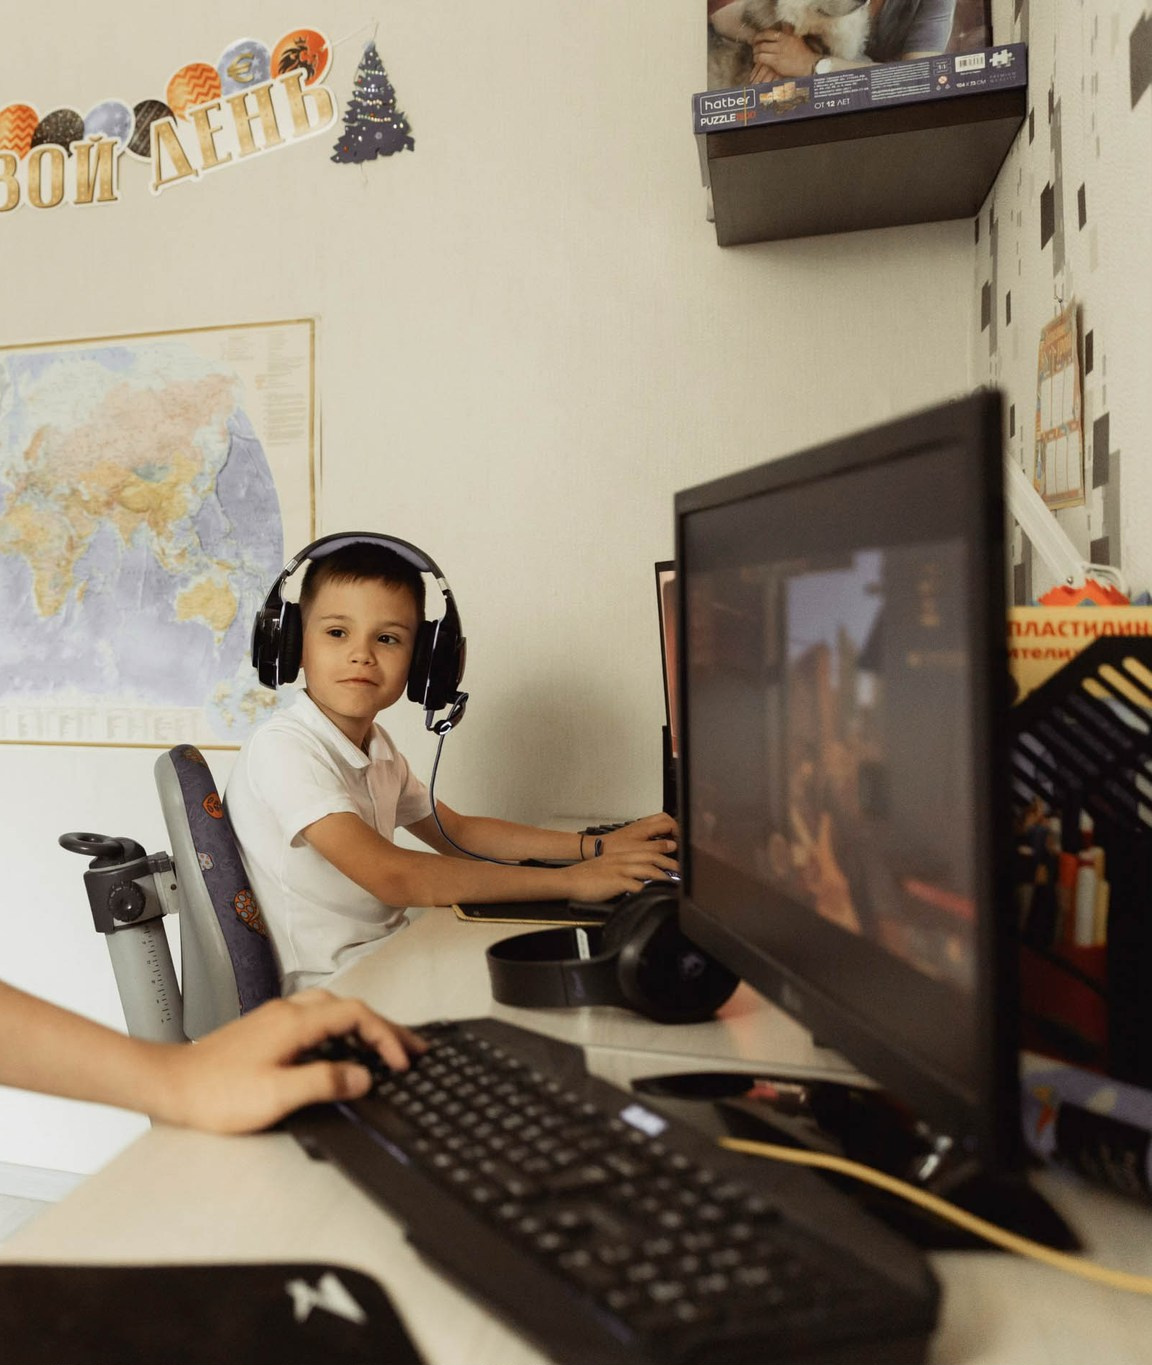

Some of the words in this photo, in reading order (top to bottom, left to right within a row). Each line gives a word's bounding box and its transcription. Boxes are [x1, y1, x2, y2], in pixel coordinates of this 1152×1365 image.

[704, 95, 750, 111] hatber
[814, 102, 825, 110] ОТ
[837, 98, 850, 106] ЛЕТ
[700, 113, 736, 126] PUZZLE
[151, 70, 335, 189] ДЕНЬ
